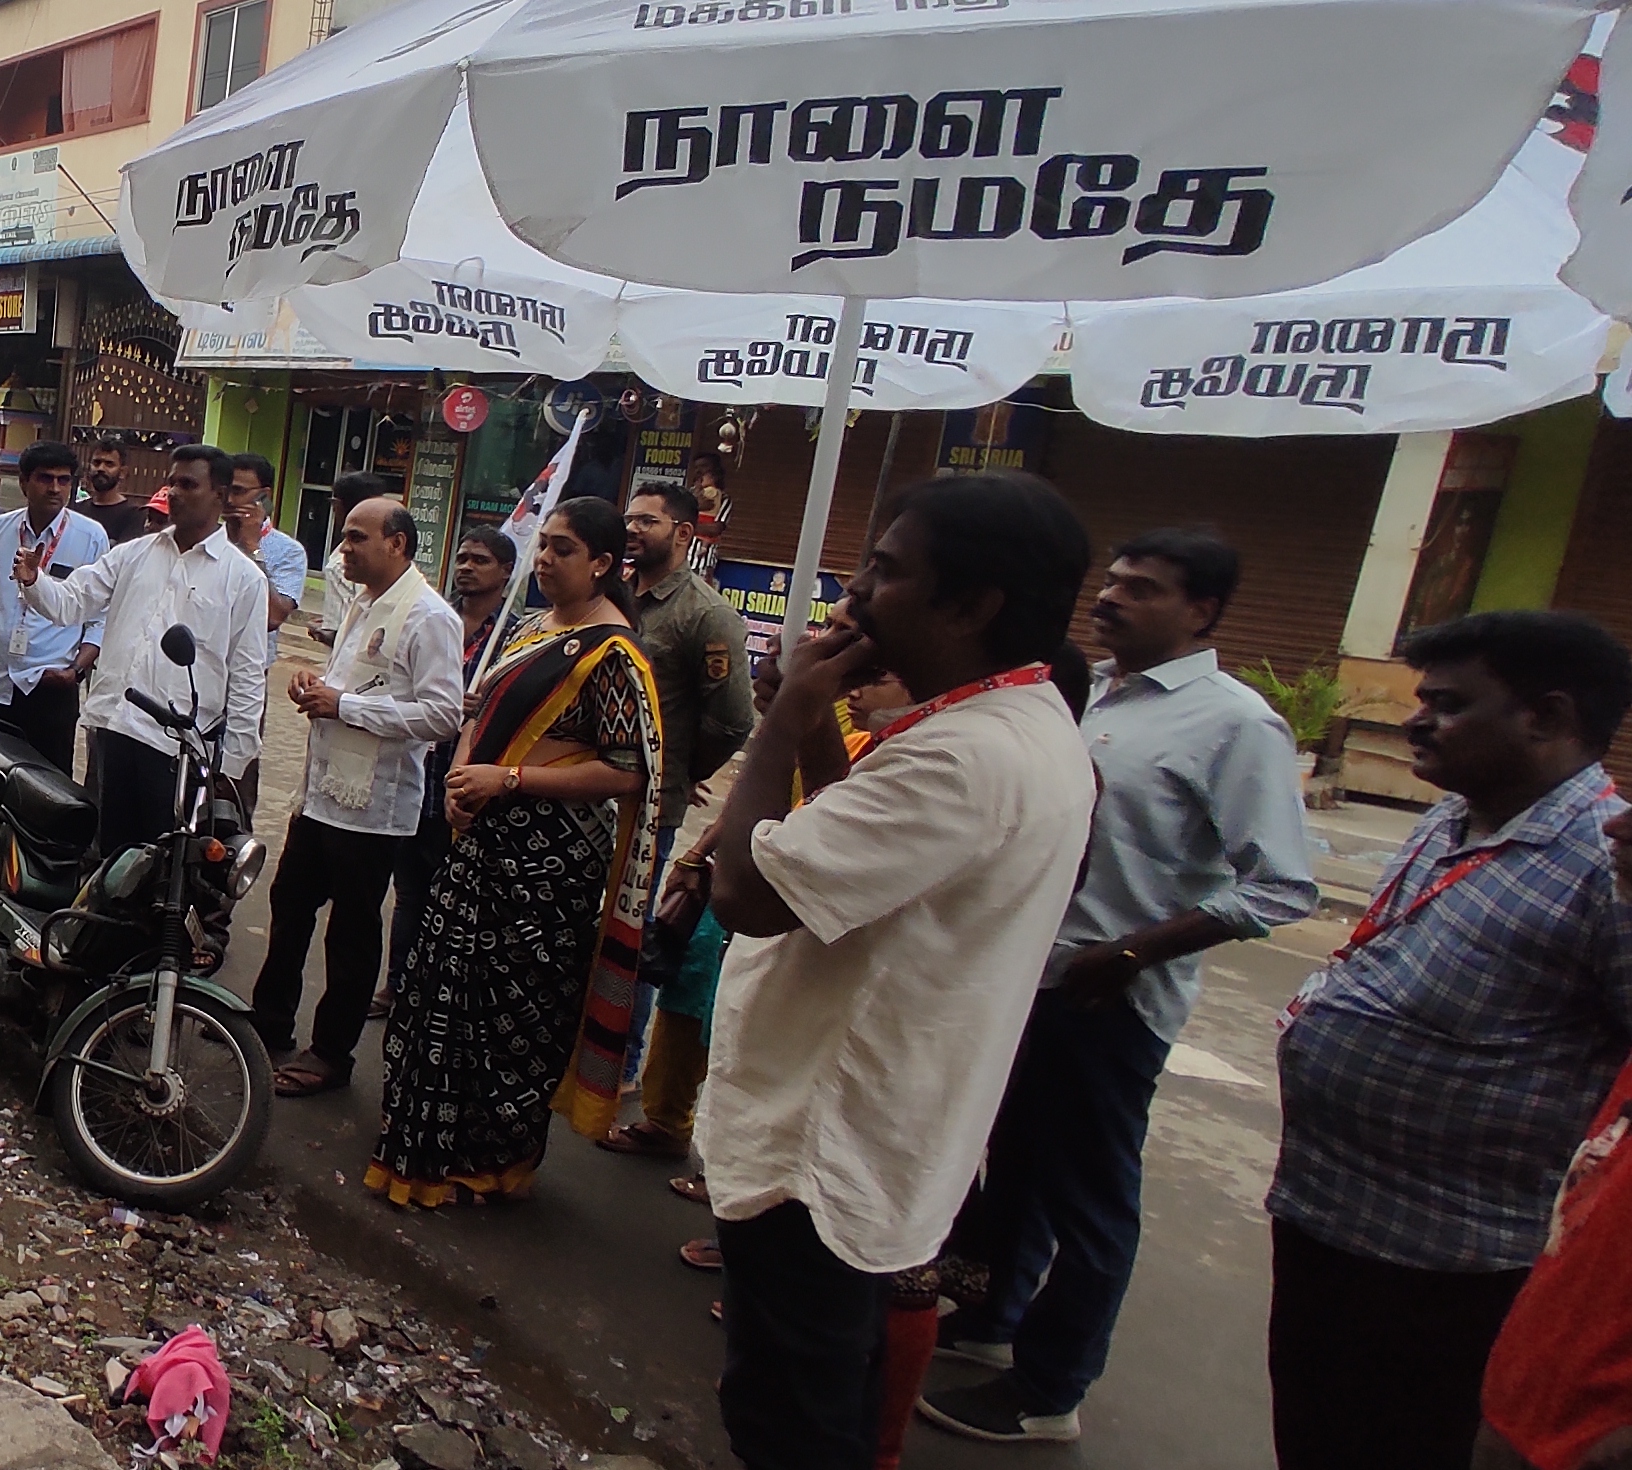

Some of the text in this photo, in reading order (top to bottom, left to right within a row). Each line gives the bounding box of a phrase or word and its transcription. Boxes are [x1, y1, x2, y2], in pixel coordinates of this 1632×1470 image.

[615, 87, 1064, 202] நாளை
[172, 139, 306, 236] நாளை
[791, 153, 1276, 273] நமதே
[226, 181, 361, 279] நமதே
[640, 430, 692, 448] SRI SRIJA
[644, 448, 681, 465] FOODS
[948, 446, 1025, 468] SRI SRIJA
[721, 587, 746, 611] SRI
[746, 591, 787, 617] SRIJA
